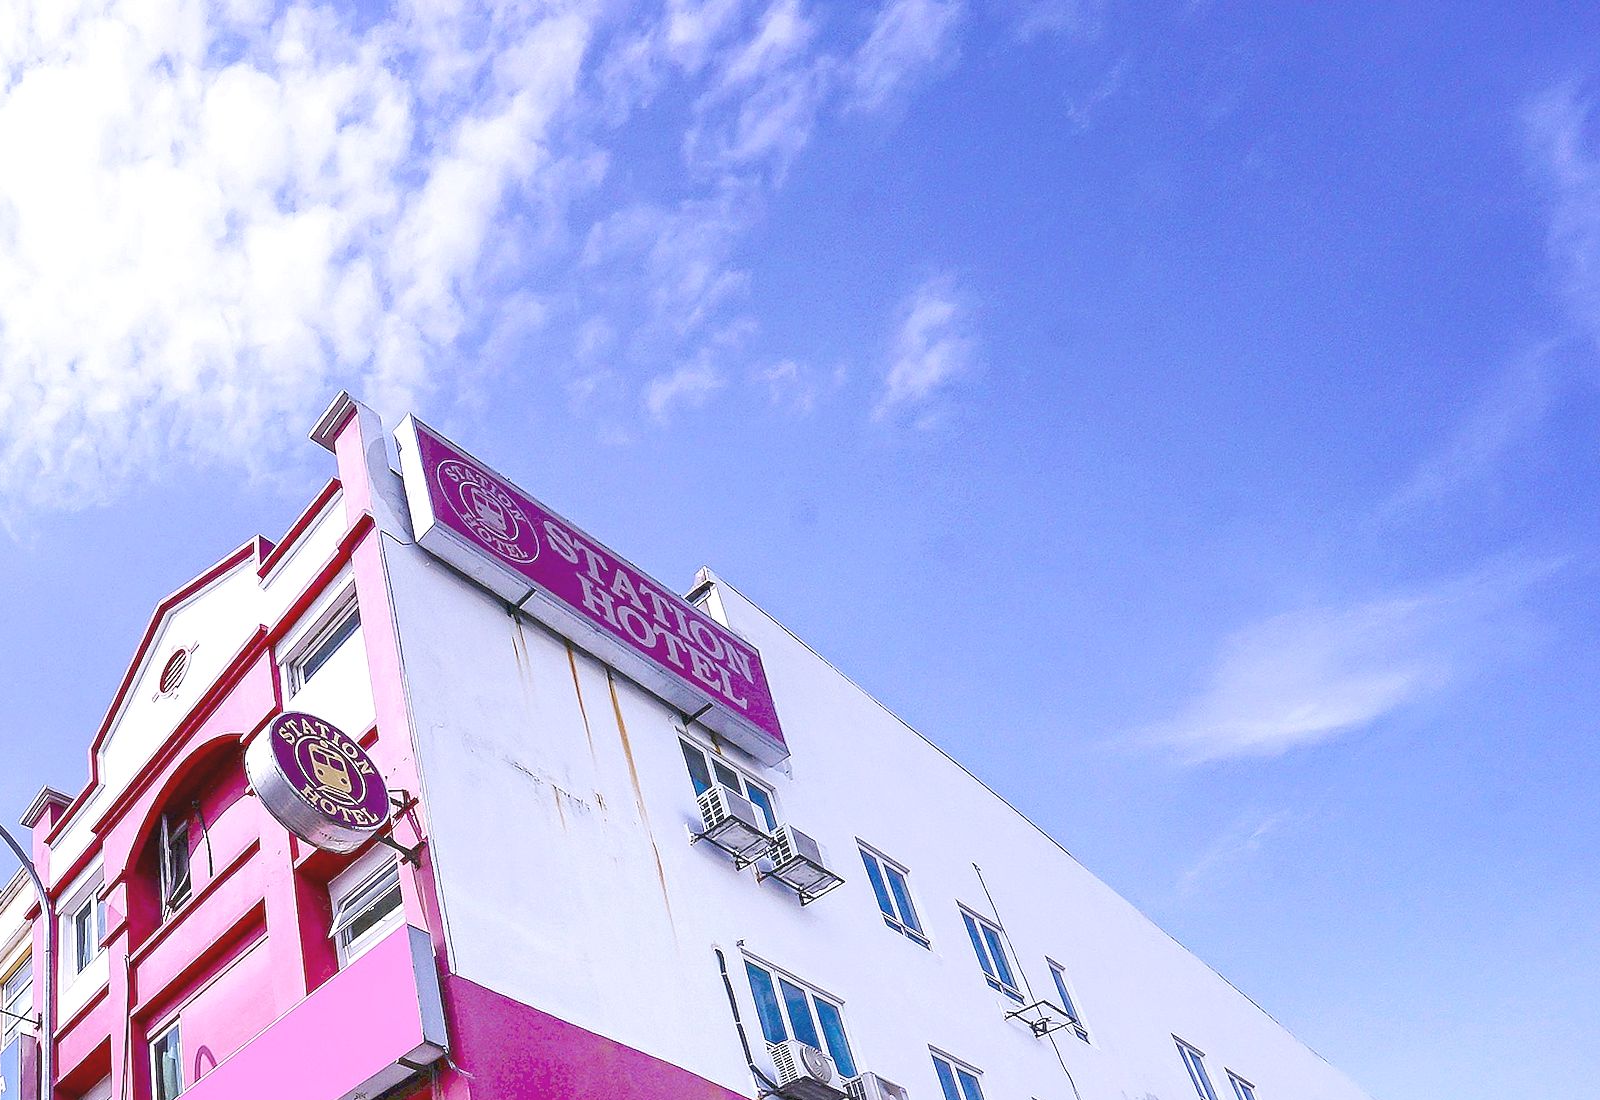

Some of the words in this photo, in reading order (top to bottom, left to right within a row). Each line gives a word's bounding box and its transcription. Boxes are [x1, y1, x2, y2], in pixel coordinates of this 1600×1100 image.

[444, 464, 527, 524] STATION
[461, 511, 529, 560] HOTEL
[543, 519, 756, 685] STATION
[575, 571, 748, 711] HOTEL
[278, 717, 375, 777] STATION
[300, 783, 379, 826] HOTEL
